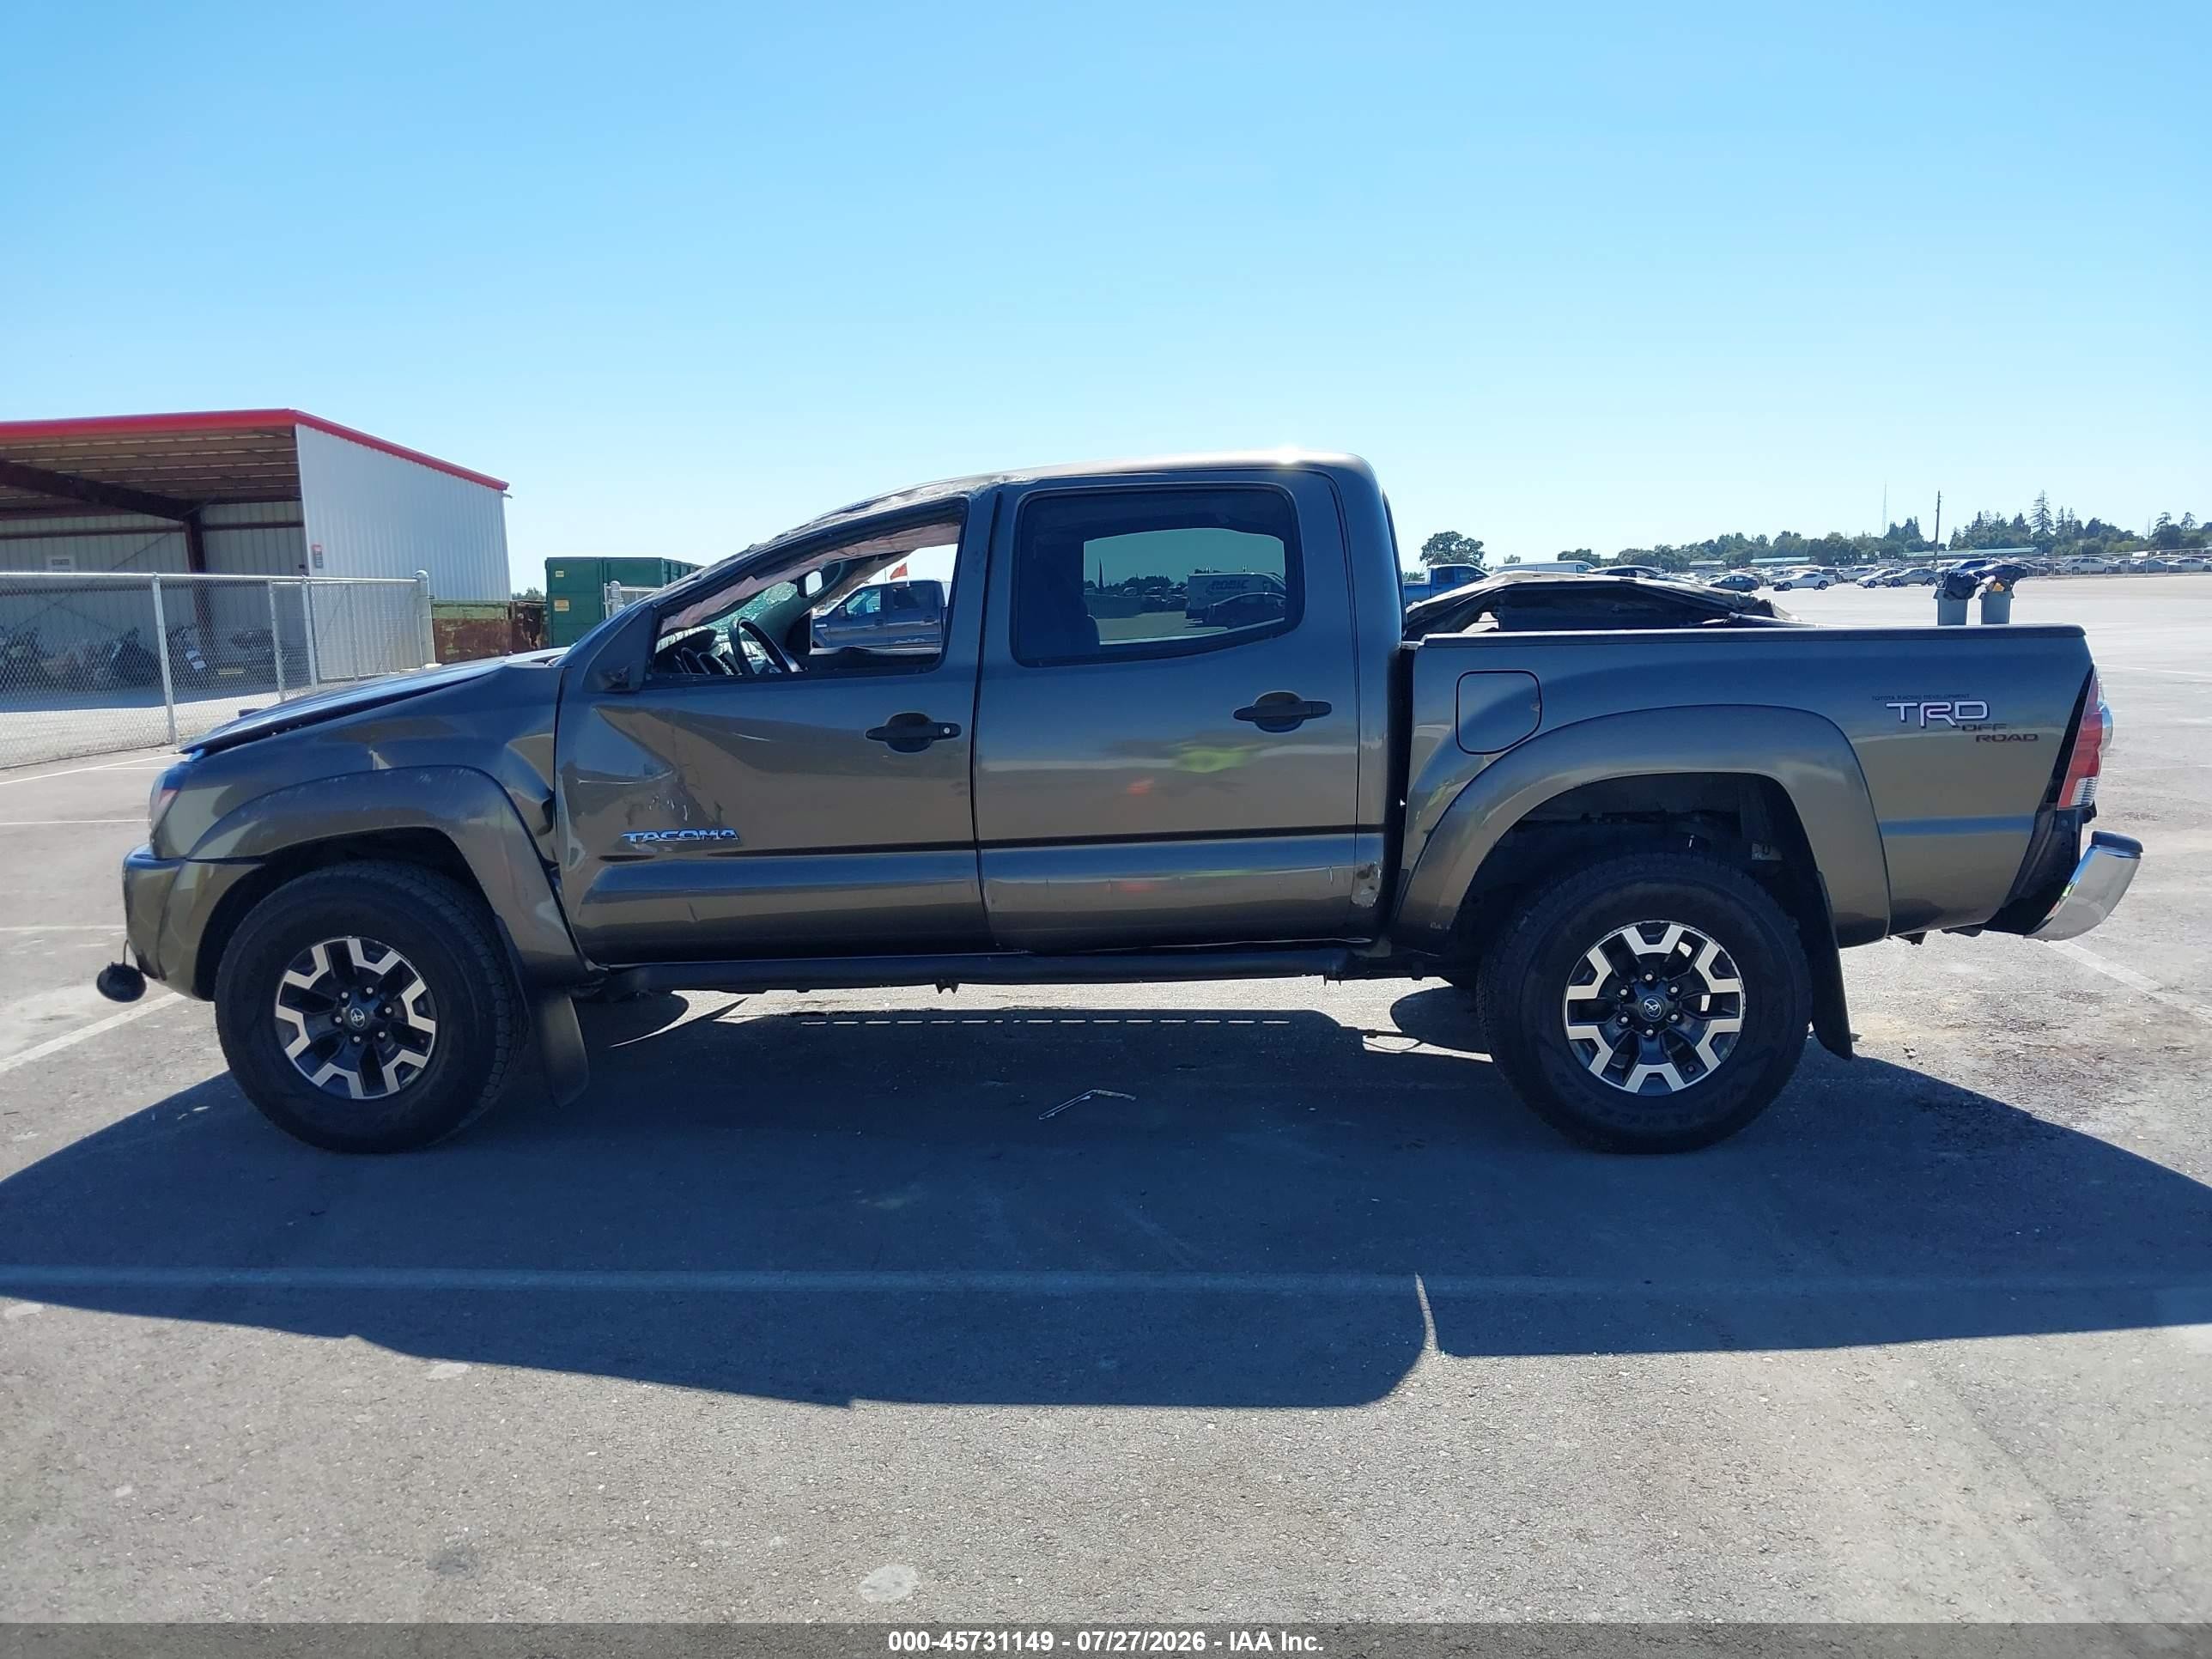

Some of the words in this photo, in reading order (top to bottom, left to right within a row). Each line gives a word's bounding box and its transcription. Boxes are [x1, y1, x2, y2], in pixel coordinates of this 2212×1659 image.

[1886, 700, 1990, 728] TRD
[1961, 723, 2007, 732] OFF
[1976, 733, 2039, 743] ROAD
[620, 828, 739, 843] TACOMA
